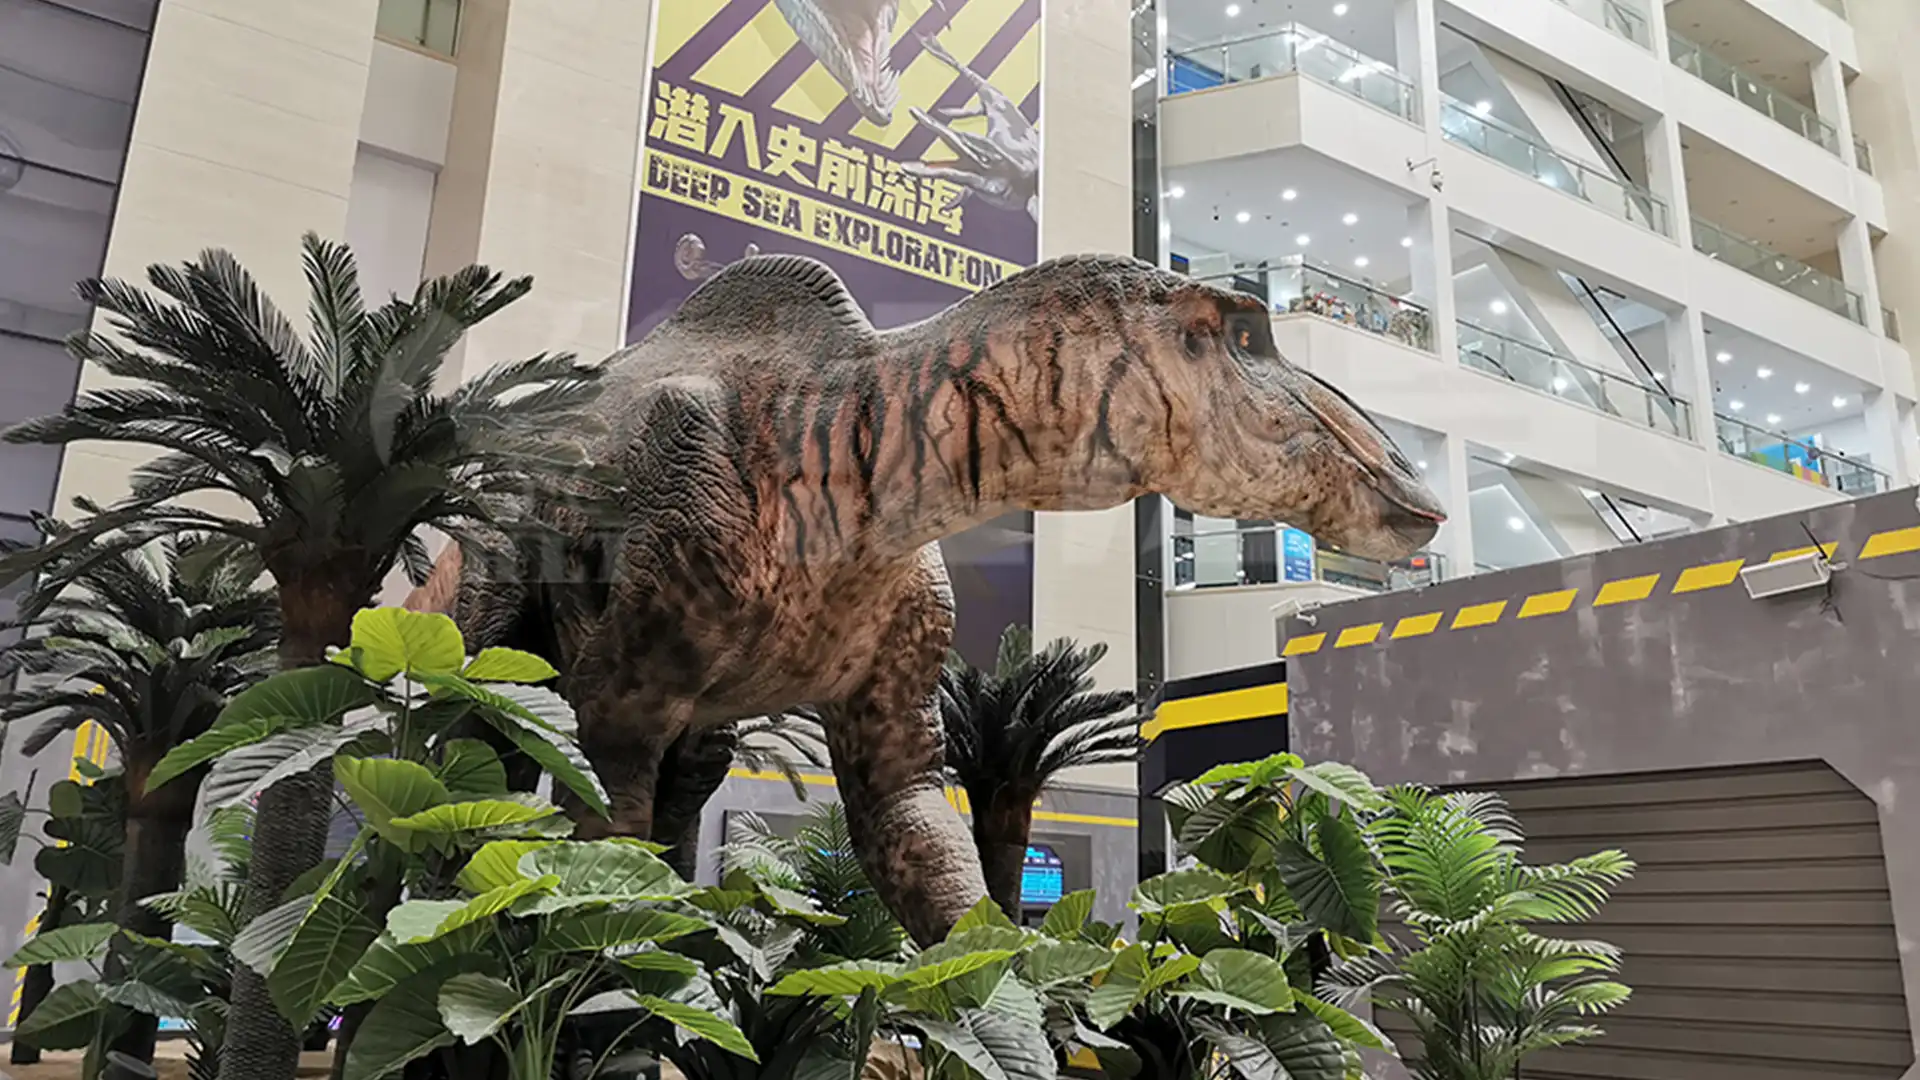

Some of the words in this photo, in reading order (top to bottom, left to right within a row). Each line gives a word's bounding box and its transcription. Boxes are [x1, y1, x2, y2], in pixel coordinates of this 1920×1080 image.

[648, 80, 964, 236] 潜入史前深海
[648, 154, 730, 207] DEEP
[742, 184, 803, 232] SEA
[814, 208, 1002, 286] EXPLORATION
